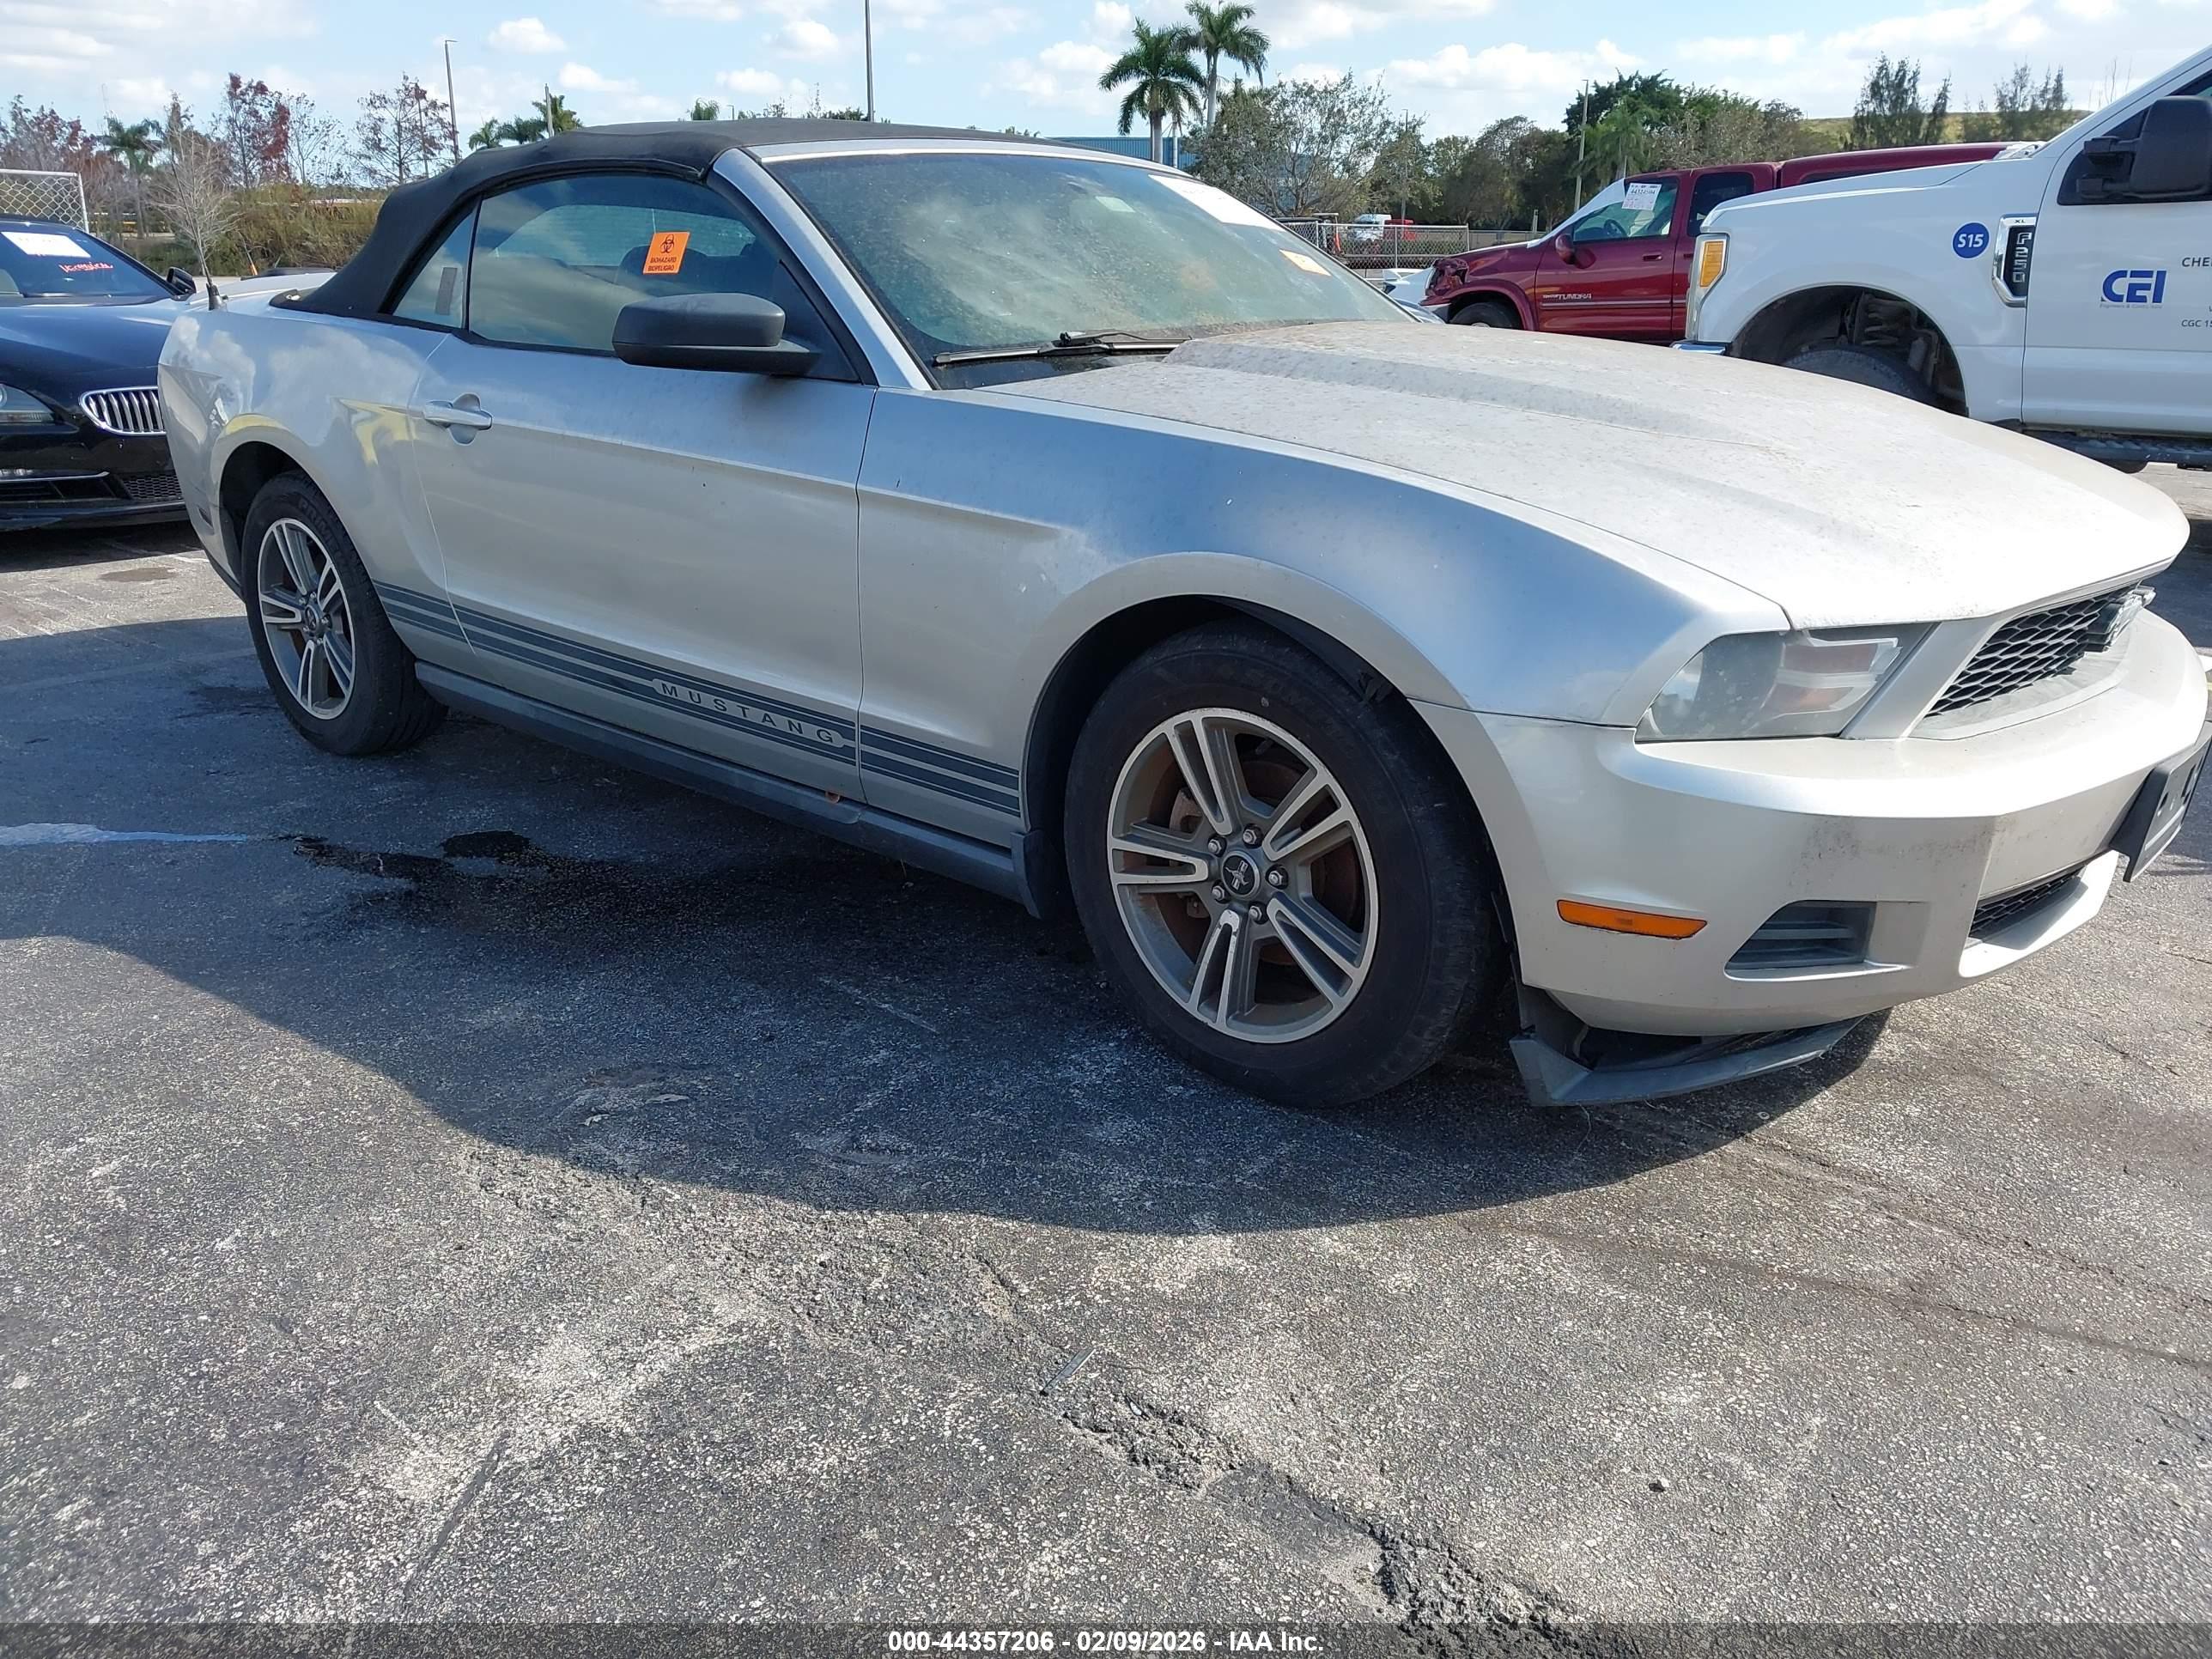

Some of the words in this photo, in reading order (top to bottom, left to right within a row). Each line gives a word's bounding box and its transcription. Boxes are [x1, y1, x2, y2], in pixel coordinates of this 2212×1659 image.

[1957, 233, 1984, 248] S15
[2012, 232, 2033, 283] F250
[2182, 257, 2212, 267] CHE
[2102, 270, 2167, 304] CEI
[2181, 319, 2202, 328] CGC
[660, 683, 834, 743] MUSTANG
